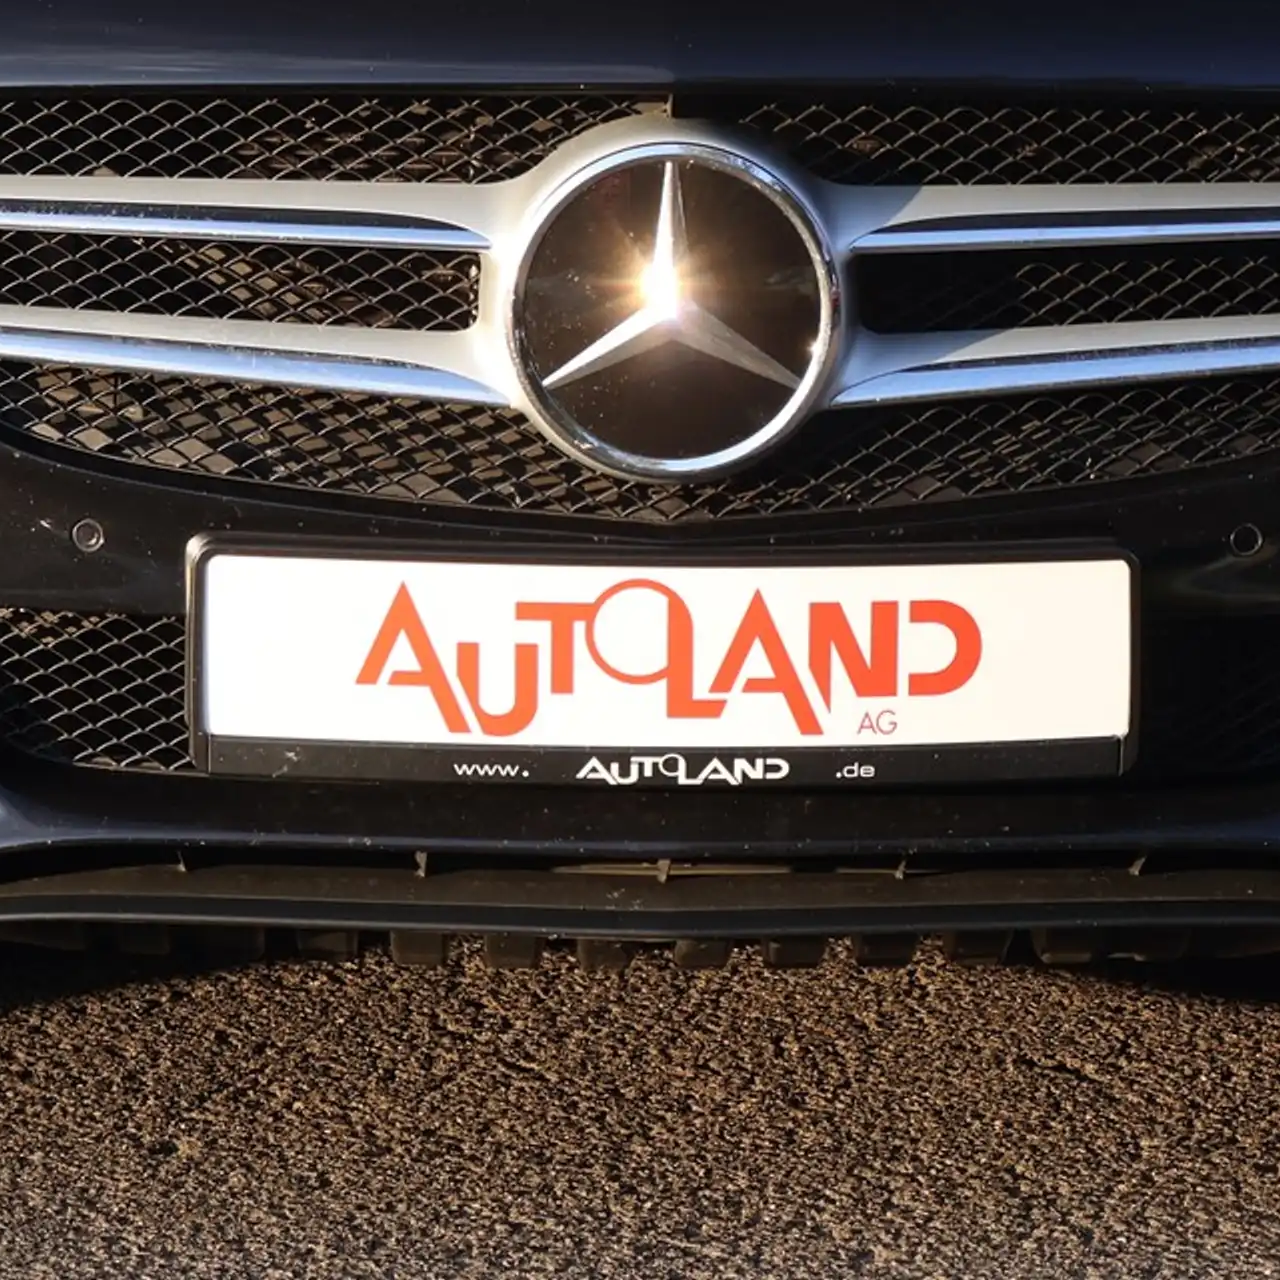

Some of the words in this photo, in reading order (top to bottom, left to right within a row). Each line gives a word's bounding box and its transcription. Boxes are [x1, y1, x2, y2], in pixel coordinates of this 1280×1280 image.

[856, 711, 899, 736] AG
[453, 762, 530, 778] www.
[835, 762, 876, 779] .de
